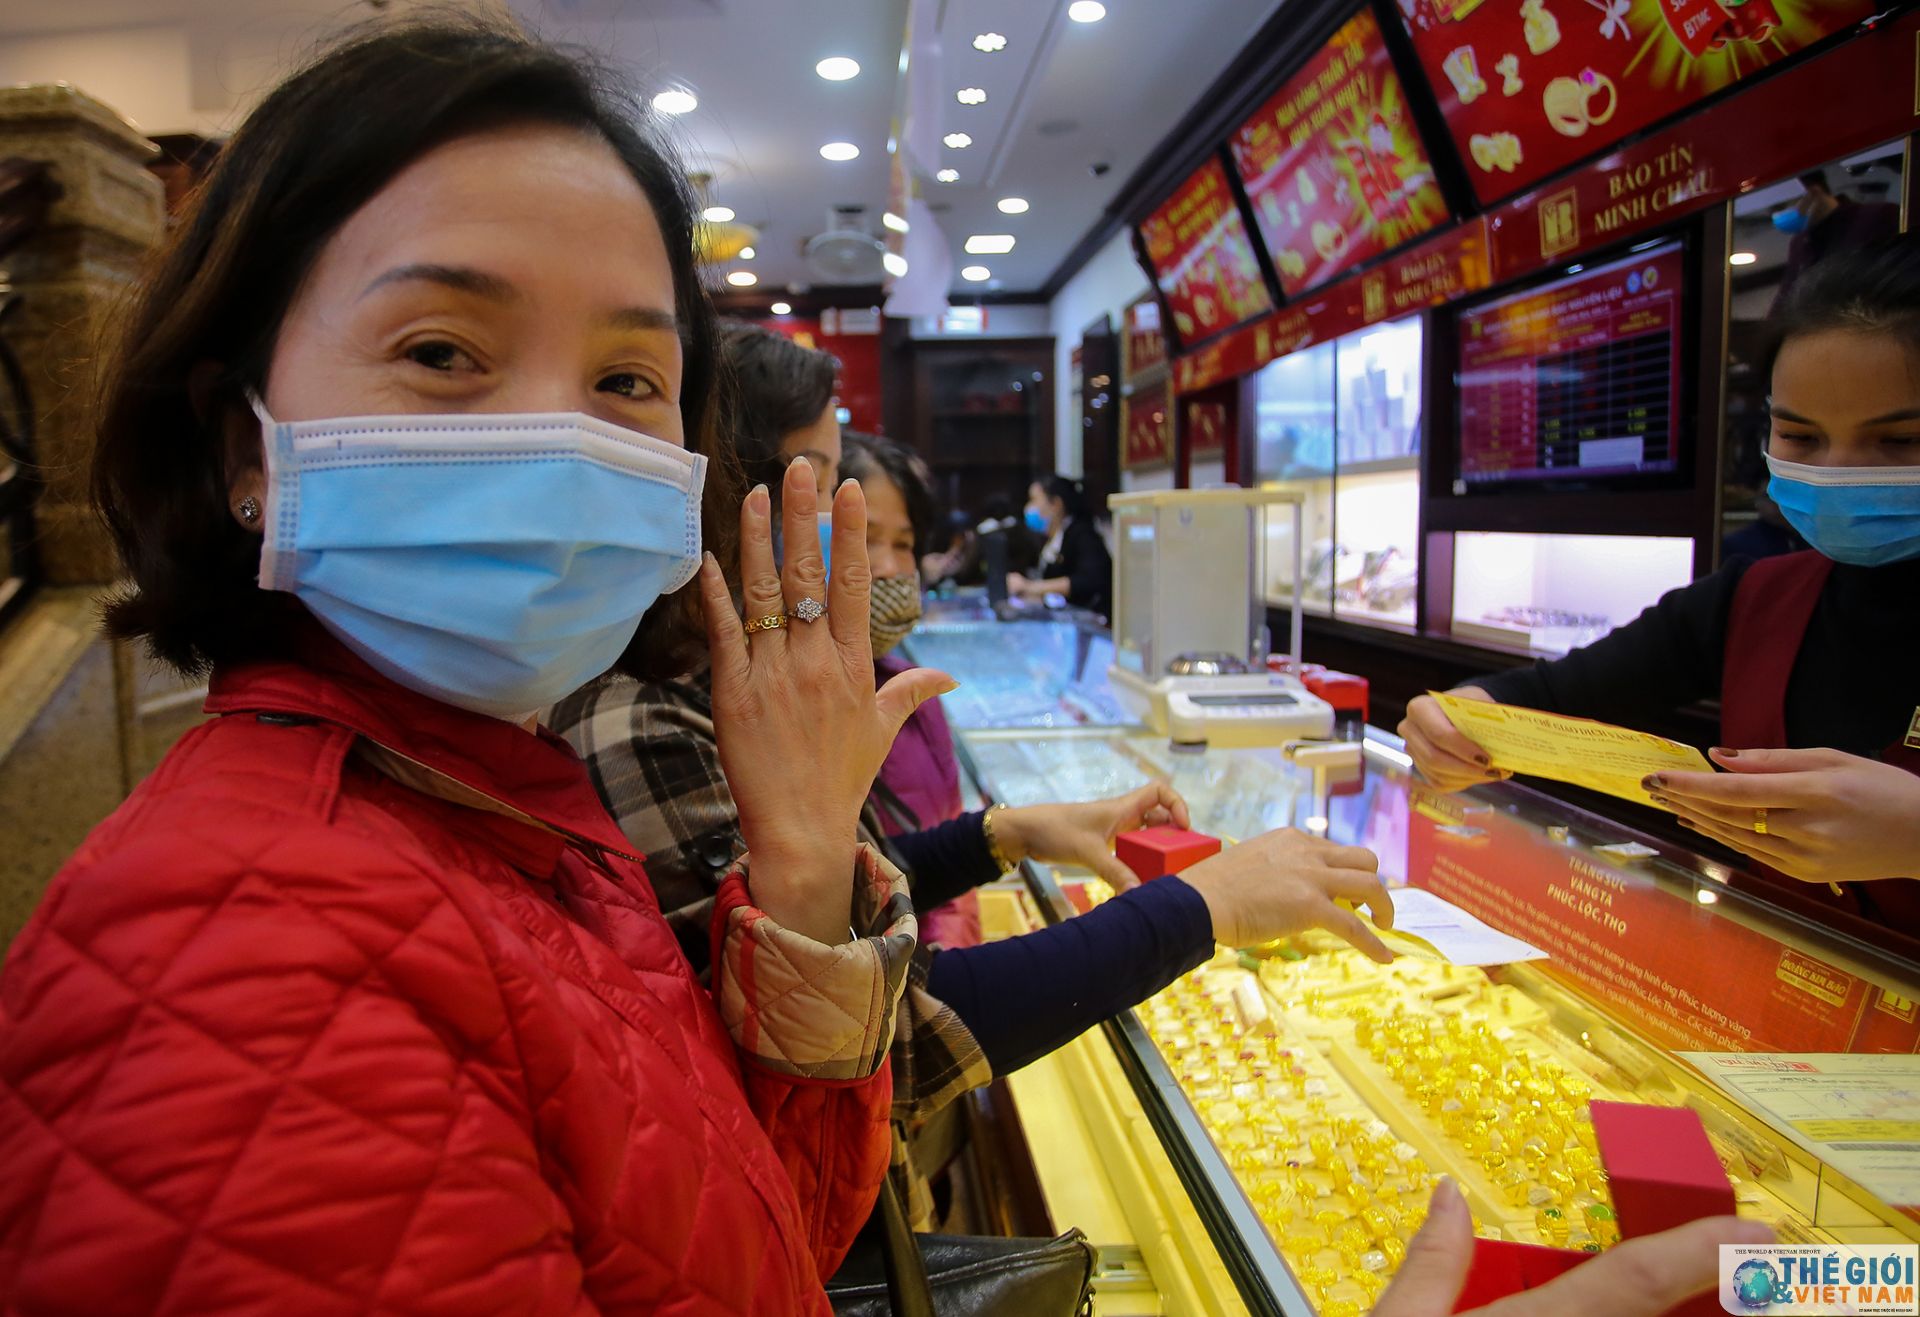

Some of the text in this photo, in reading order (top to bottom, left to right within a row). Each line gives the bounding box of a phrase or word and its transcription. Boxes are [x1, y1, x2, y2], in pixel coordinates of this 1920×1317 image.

[1609, 143, 1693, 198] BẢO TÍN
[1594, 168, 1713, 233] MINH CHÂU
[1568, 855, 1605, 884] TRANG
[1600, 889, 1613, 908] TA
[1603, 911, 1627, 938] THỌ
[1643, 969, 1661, 988] hình
[1661, 979, 1678, 1000] ông
[1677, 988, 1699, 1011] Phúc,
[1701, 1003, 1728, 1027] tượng
[1728, 1019, 1752, 1041] vàng
[1702, 1025, 1718, 1042] sản
[1716, 1036, 1745, 1055] phẩm
